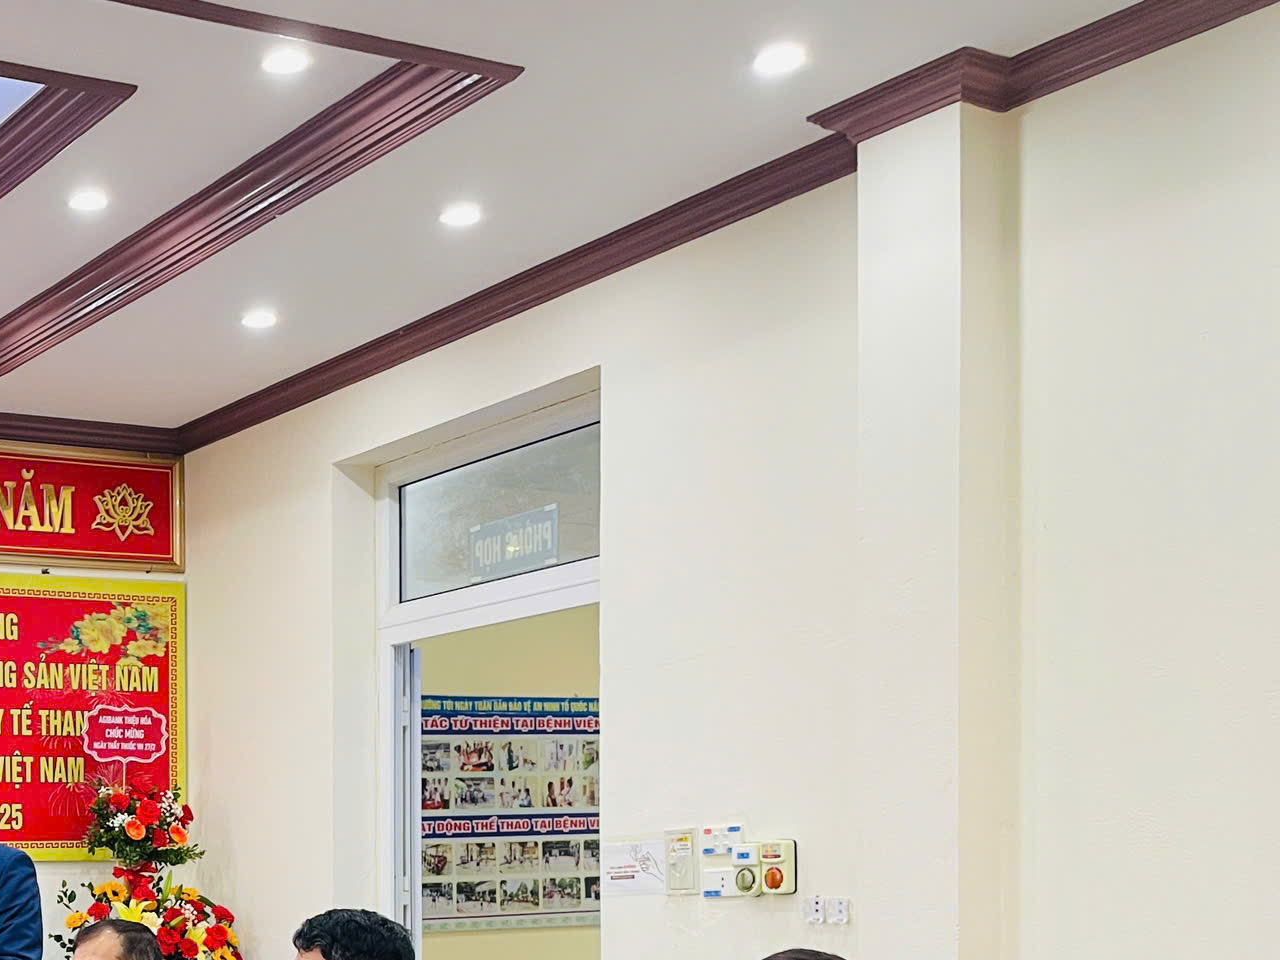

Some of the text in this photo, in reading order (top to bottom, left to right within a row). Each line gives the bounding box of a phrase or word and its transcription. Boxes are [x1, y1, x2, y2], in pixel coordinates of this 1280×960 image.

[23, 653, 64, 691] SẢN
[69, 658, 110, 697] VIỆT
[115, 663, 159, 693] NAM
[10, 700, 34, 737] TẾ
[38, 709, 89, 737] THAN
[471, 716, 510, 732] THIỆN
[514, 717, 534, 732] TẠI
[536, 716, 572, 732] BỆNH
[105, 726, 124, 739] CHÚC
[39, 756, 85, 783] NAM
[435, 819, 471, 835] ĐỘNG
[500, 819, 529, 831] THAO
[533, 818, 552, 833] TẠI
[554, 816, 587, 832] BỆNH
